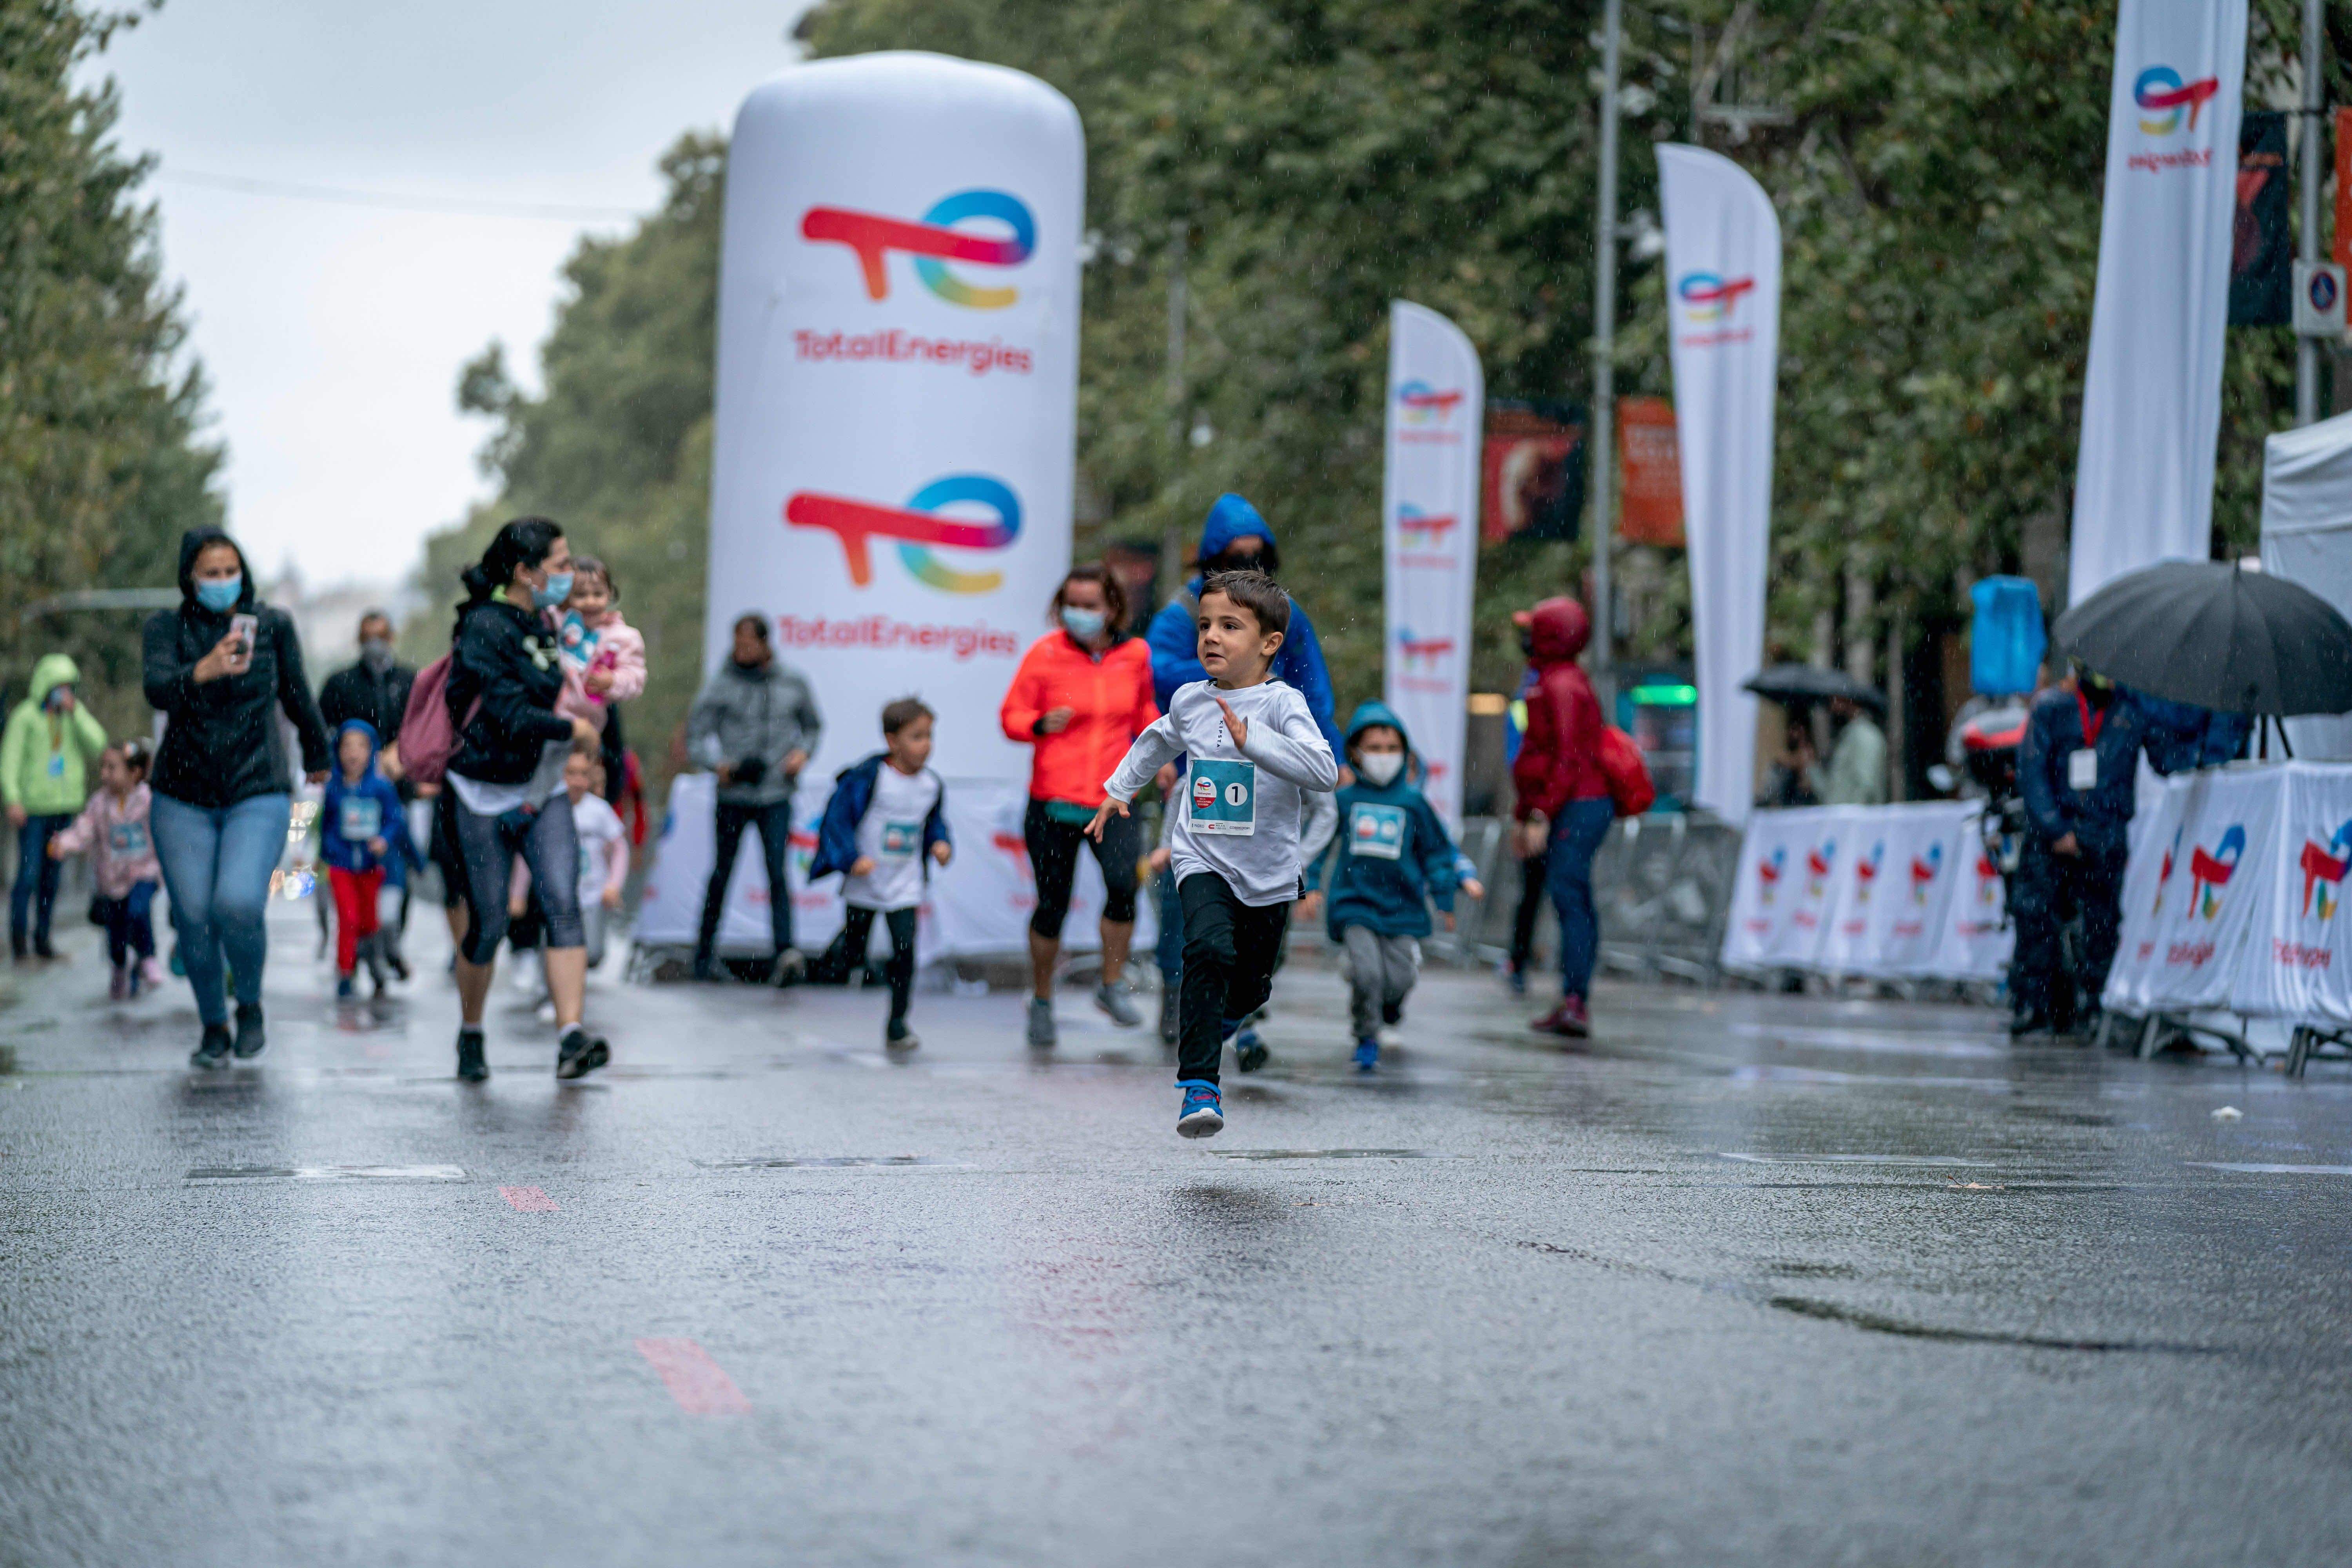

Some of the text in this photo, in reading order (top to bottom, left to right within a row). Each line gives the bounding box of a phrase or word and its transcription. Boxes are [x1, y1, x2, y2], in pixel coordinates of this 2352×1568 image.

[794, 329, 1033, 376] TotalEnergies
[779, 615, 1018, 662] TotalEnergies
[1232, 786, 1238, 803] 1
